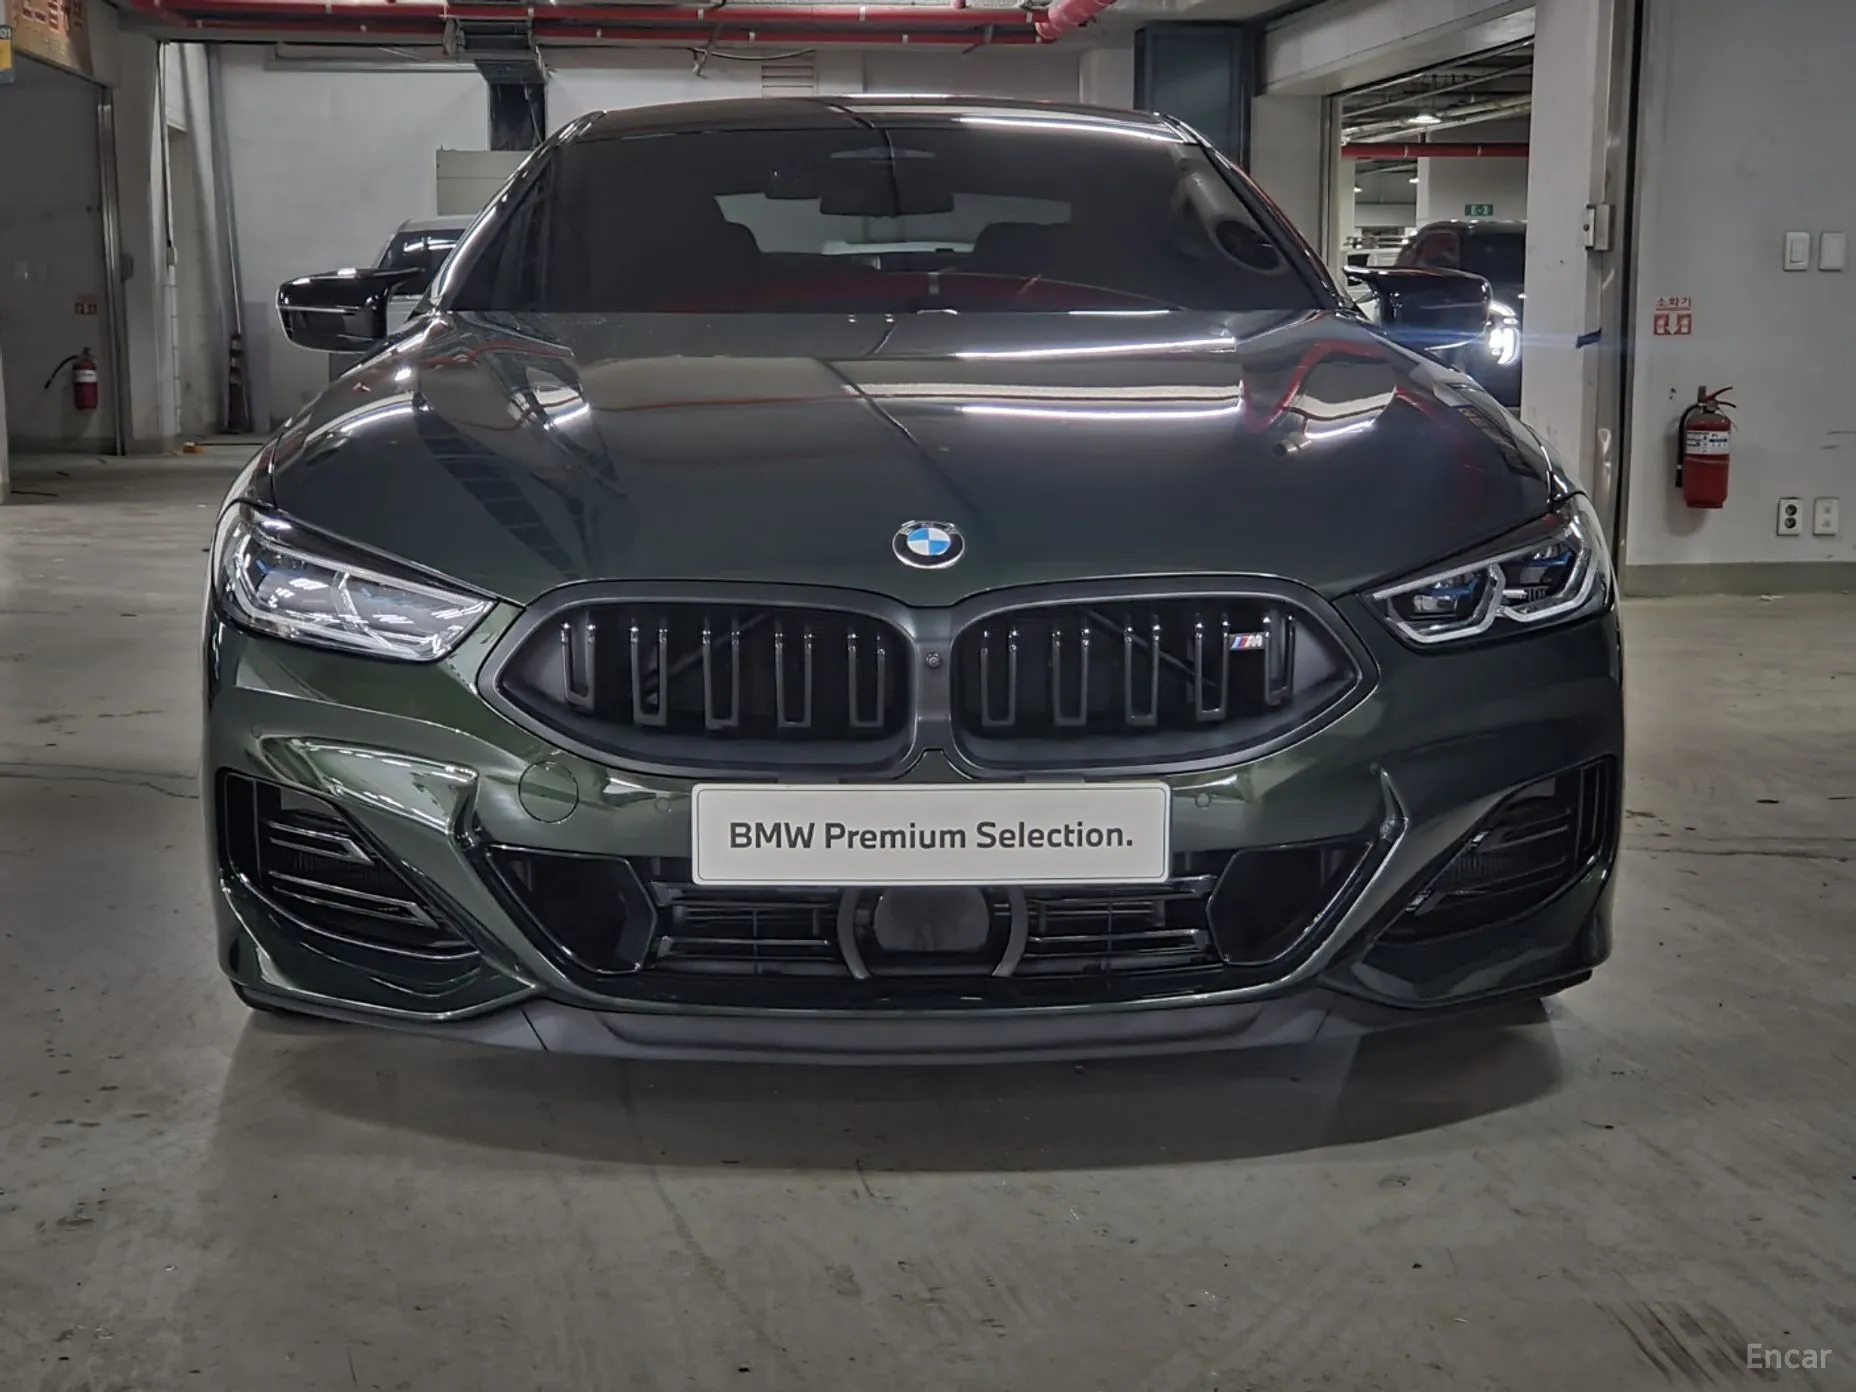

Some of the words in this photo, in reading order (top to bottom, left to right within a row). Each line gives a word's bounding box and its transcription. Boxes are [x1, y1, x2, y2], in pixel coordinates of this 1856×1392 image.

[729, 822, 815, 849] BMW
[825, 822, 966, 849] Premium
[976, 821, 1133, 849] Selection.
